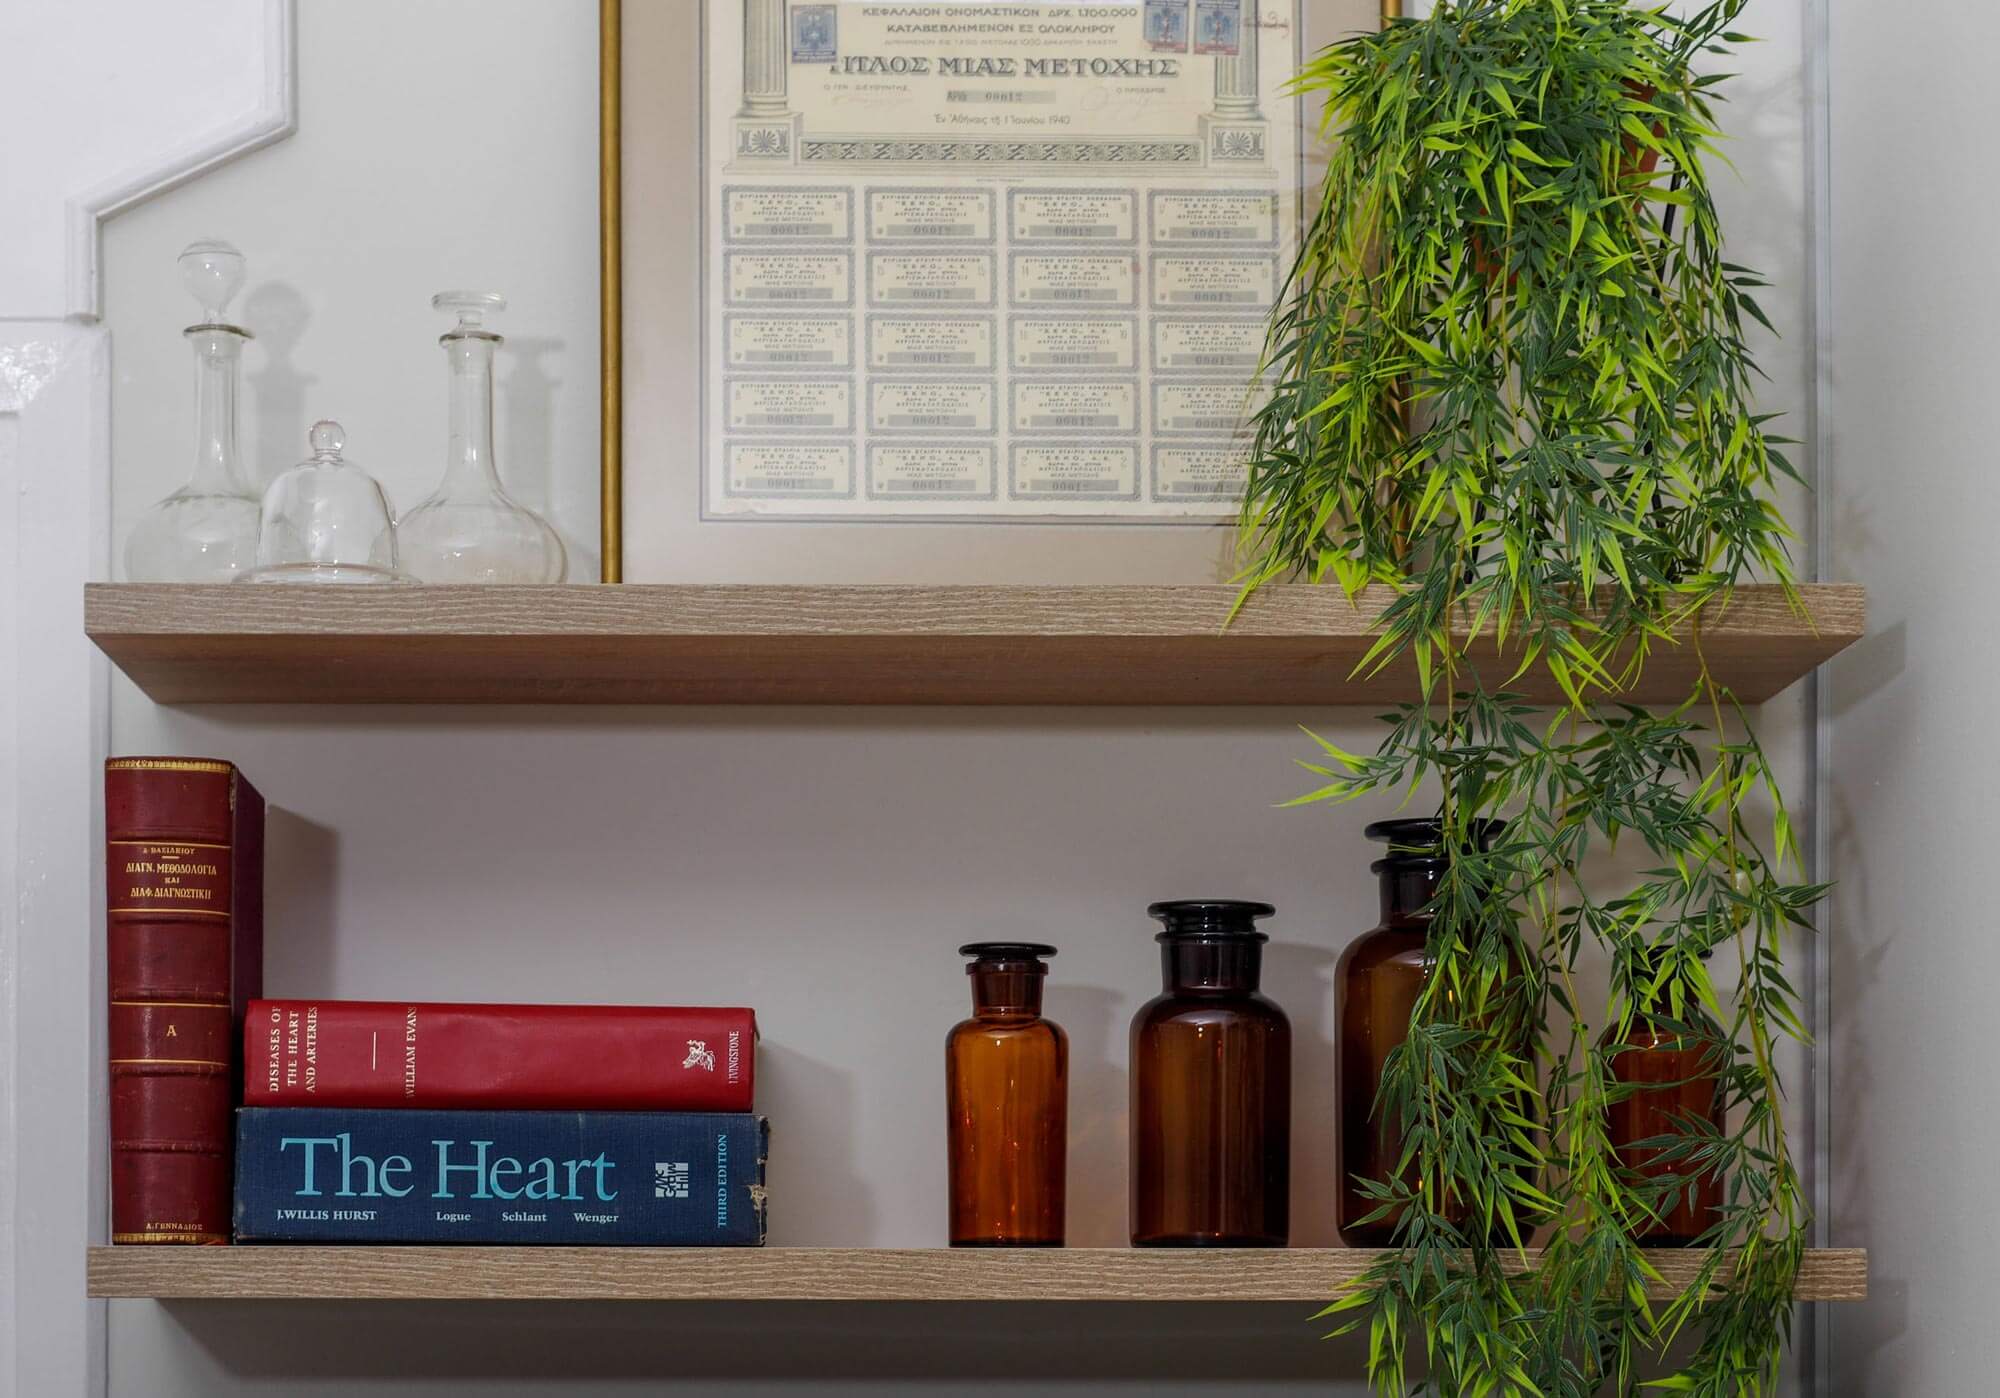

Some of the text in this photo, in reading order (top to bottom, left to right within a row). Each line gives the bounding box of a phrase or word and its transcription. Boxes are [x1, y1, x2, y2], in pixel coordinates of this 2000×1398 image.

[862, 7, 941, 17] ΚΕΦΑΛΑΙΟΝ
[944, 7, 1040, 17] ΟΝΟΜΑΣΤΙΚΟΝ
[1038, 24, 1116, 34] ΟΛΟΚΛΗΡΟΥ
[937, 55, 1018, 77] ΜΙΑΣ
[1023, 56, 1181, 78] ΜΕΤΟΧΗΣ
[1048, 114, 1072, 126] 1940
[126, 862, 217, 875] ΔΙΑΓΝ. ΜΕΘΟΔΟΛΟΓΙΑ
[154, 888, 211, 899] ΔΙΑΓΝΩΣΤΙΚΗ
[406, 1006, 417, 1042] EVANS
[287, 1010, 299, 1087] THE HEART
[305, 1006, 318, 1093] AND ARTERIES
[269, 1027, 281, 1093] DISEASES
[280, 1132, 619, 1201] The Heart
[717, 1134, 728, 1229] THIRD EDITION
[333, 1210, 377, 1221] HURST
[436, 1210, 472, 1223] Logue
[502, 1210, 548, 1222] Schlant
[573, 1211, 619, 1224] Wenger
